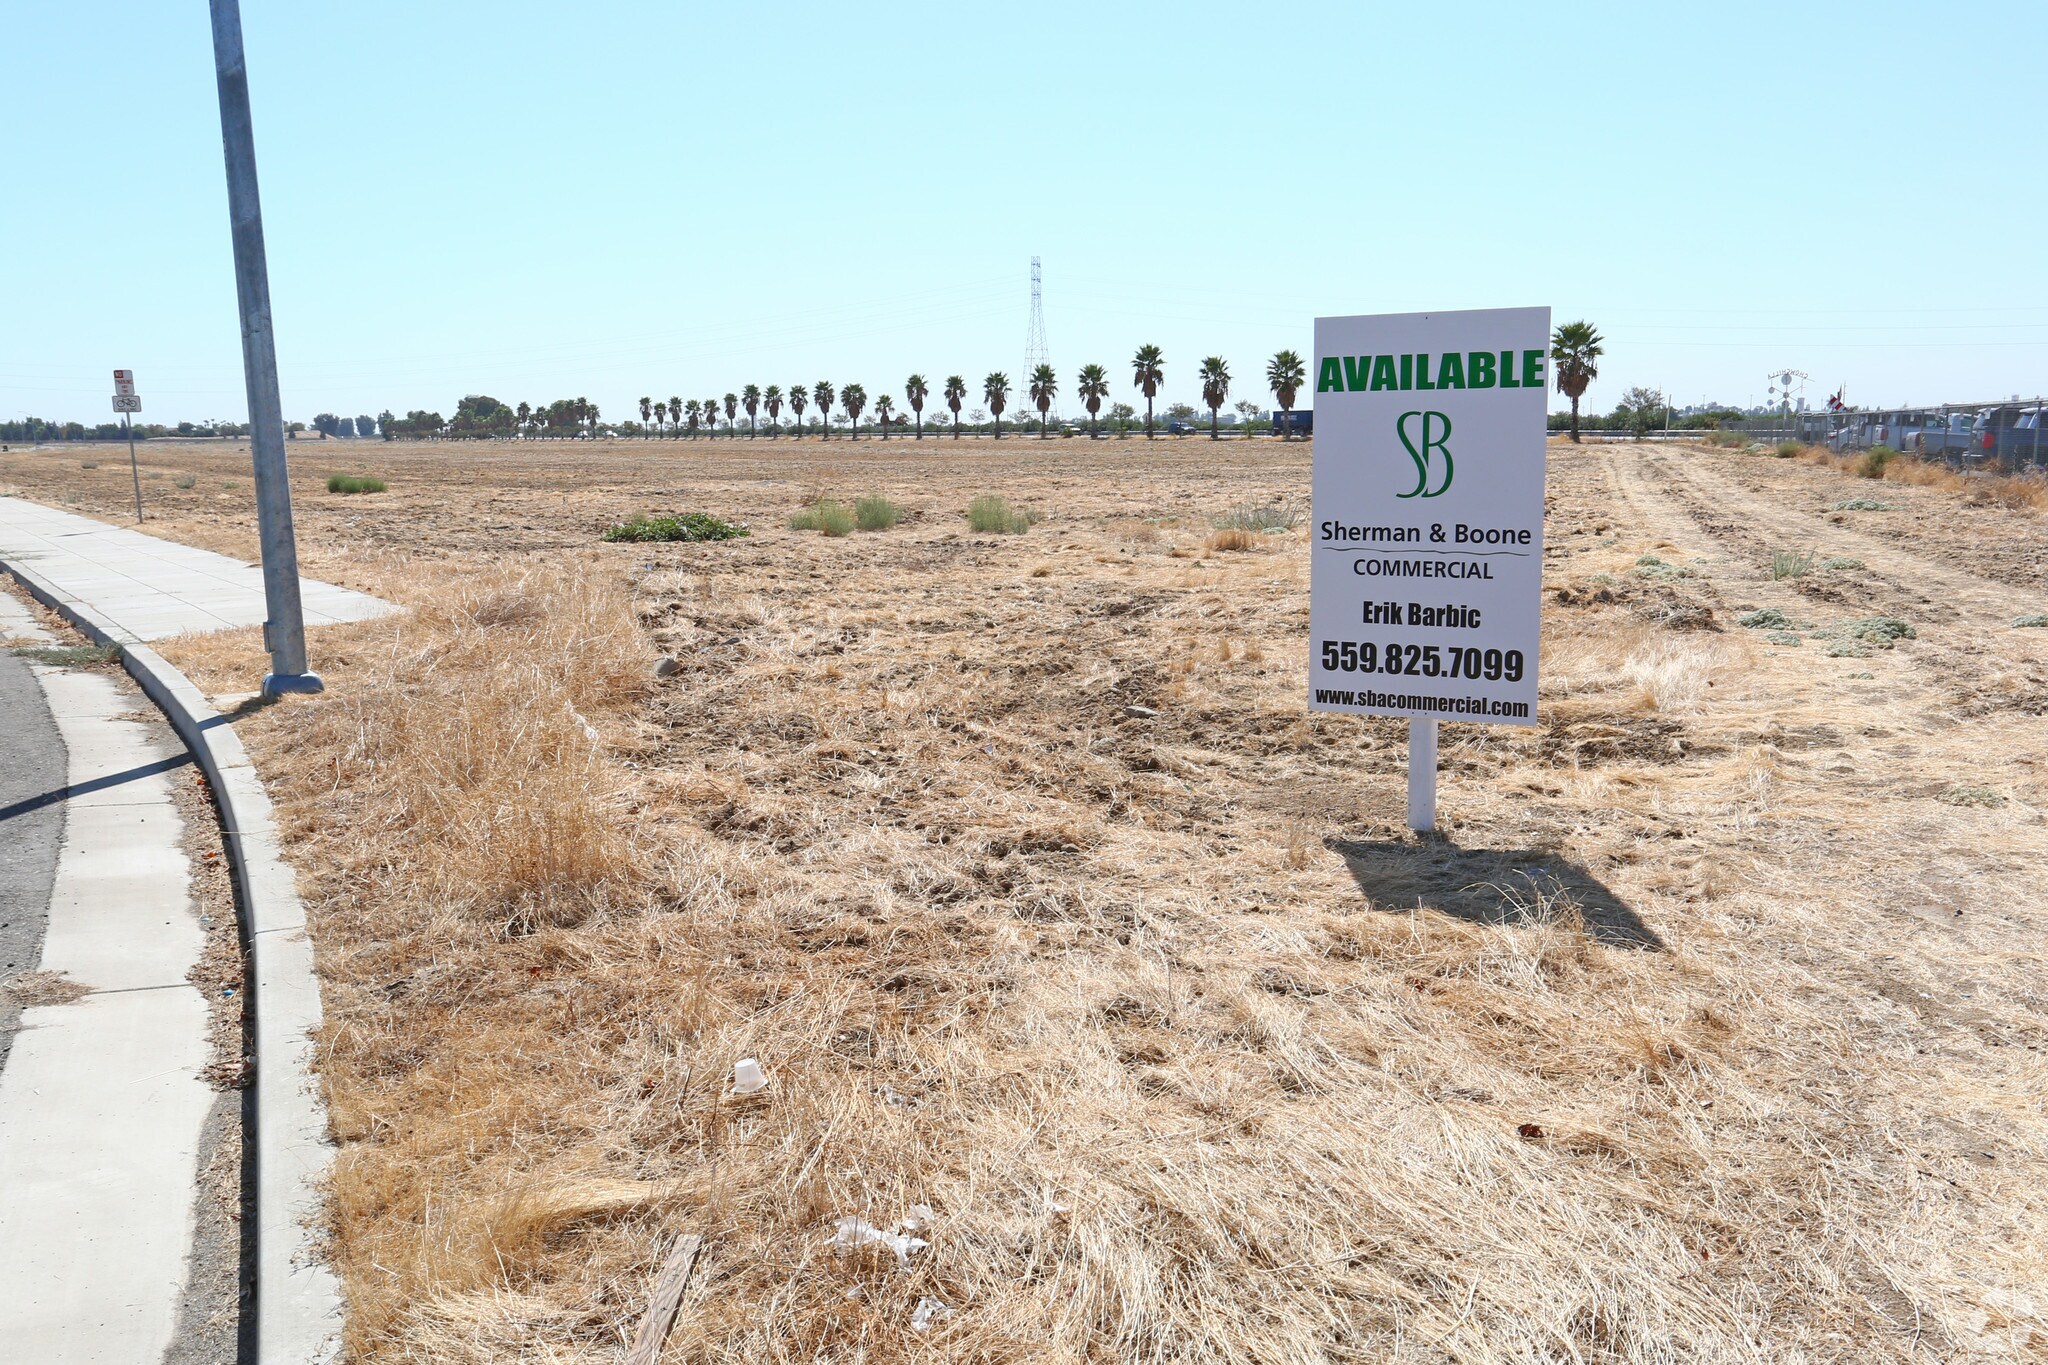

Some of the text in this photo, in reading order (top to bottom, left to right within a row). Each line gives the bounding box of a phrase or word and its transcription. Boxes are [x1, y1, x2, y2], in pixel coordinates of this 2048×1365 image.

[1317, 350, 1545, 392] AVAILABLE
[1396, 411, 1454, 498] SB
[1321, 521, 1532, 545] Sherman & Boone
[1353, 558, 1494, 579] COMMERCIAL
[1363, 600, 1481, 628] Erik Barbic
[1322, 640, 1524, 682] 559.825.7099
[1315, 689, 1529, 718] www.sbacommercial.com
